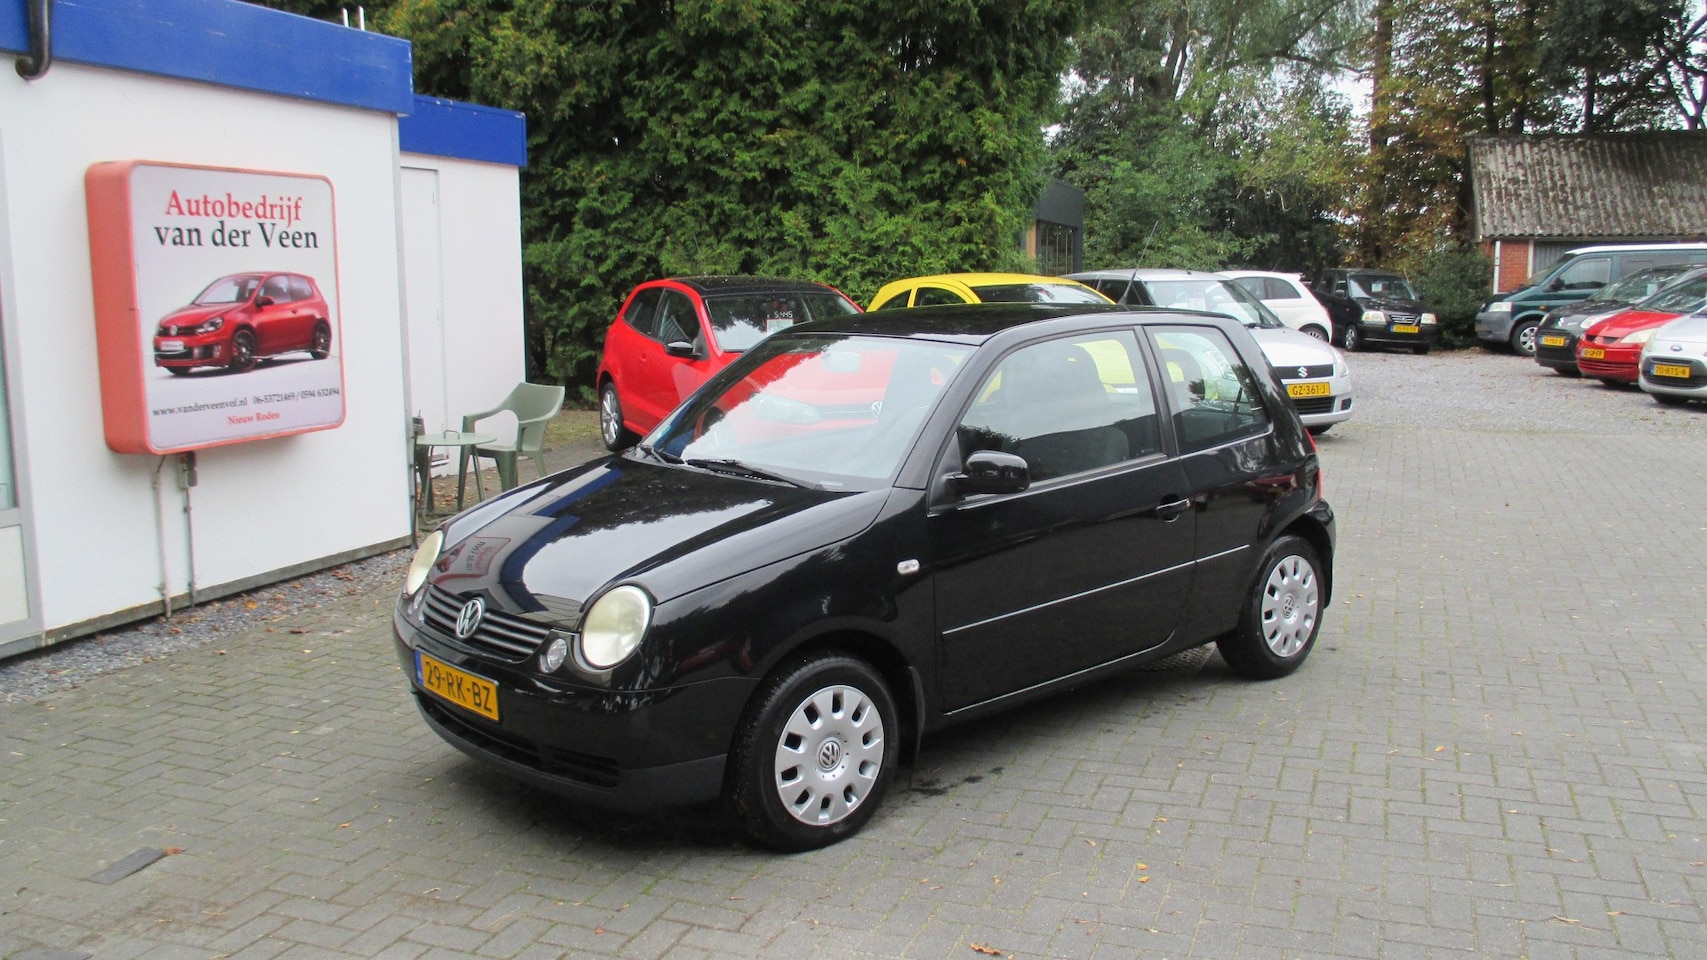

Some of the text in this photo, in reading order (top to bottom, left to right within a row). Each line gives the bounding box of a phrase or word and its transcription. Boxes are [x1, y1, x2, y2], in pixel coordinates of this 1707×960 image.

[165, 189, 302, 228] Autobedrijf
[154, 220, 319, 249] van der Veen
[153, 399, 247, 416] www.vanderveenvof.nl
[253, 392, 295, 404] 06-53721469
[317, 387, 340, 397] 632494
[1292, 385, 1326, 396] GZ-361-J
[228, 412, 280, 425] Nieuw Roden
[425, 661, 493, 713] 29-RK-BZ
